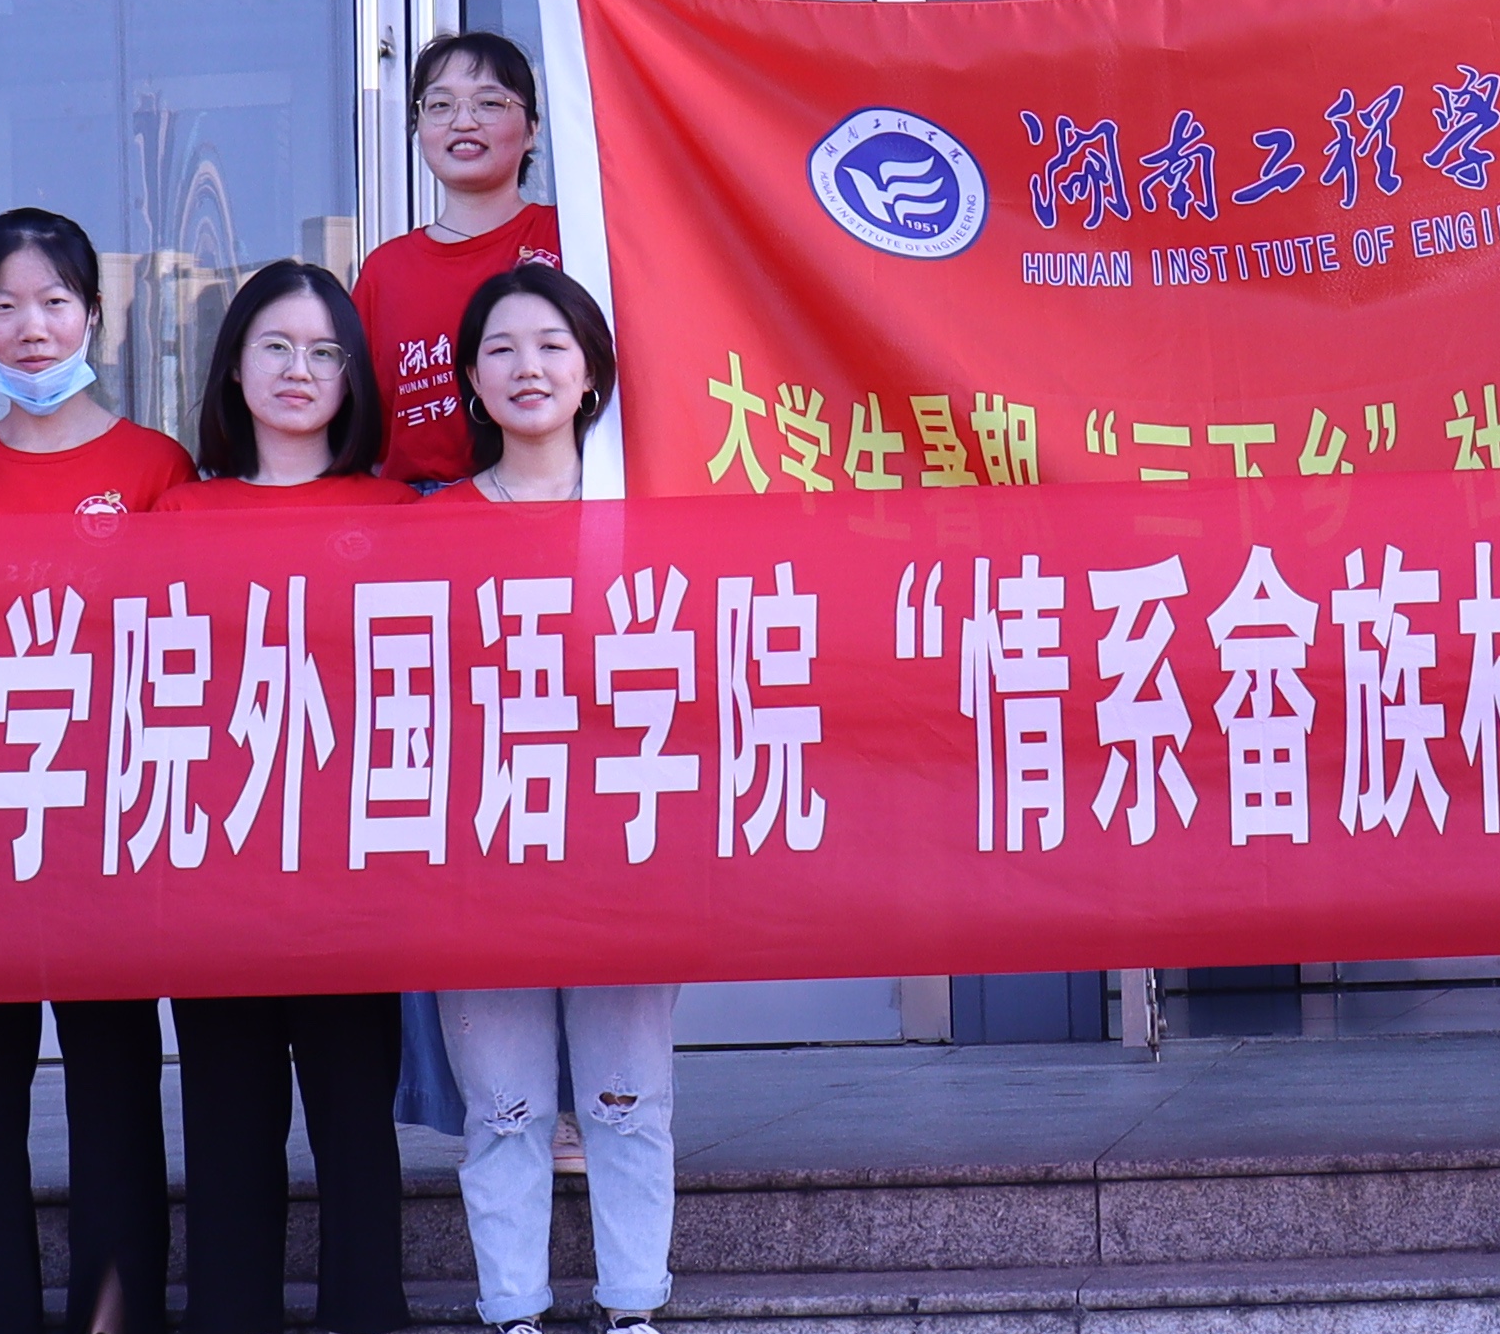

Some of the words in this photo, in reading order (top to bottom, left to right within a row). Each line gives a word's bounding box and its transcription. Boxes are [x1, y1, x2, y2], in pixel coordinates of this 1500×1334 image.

[905, 218, 940, 235] 1951
[1022, 248, 1132, 287] HUNAN
[1151, 232, 1339, 287] INSTITUTE
[1352, 224, 1395, 268] OF
[398, 333, 452, 378] 湖南
[398, 376, 430, 397] HUNAN
